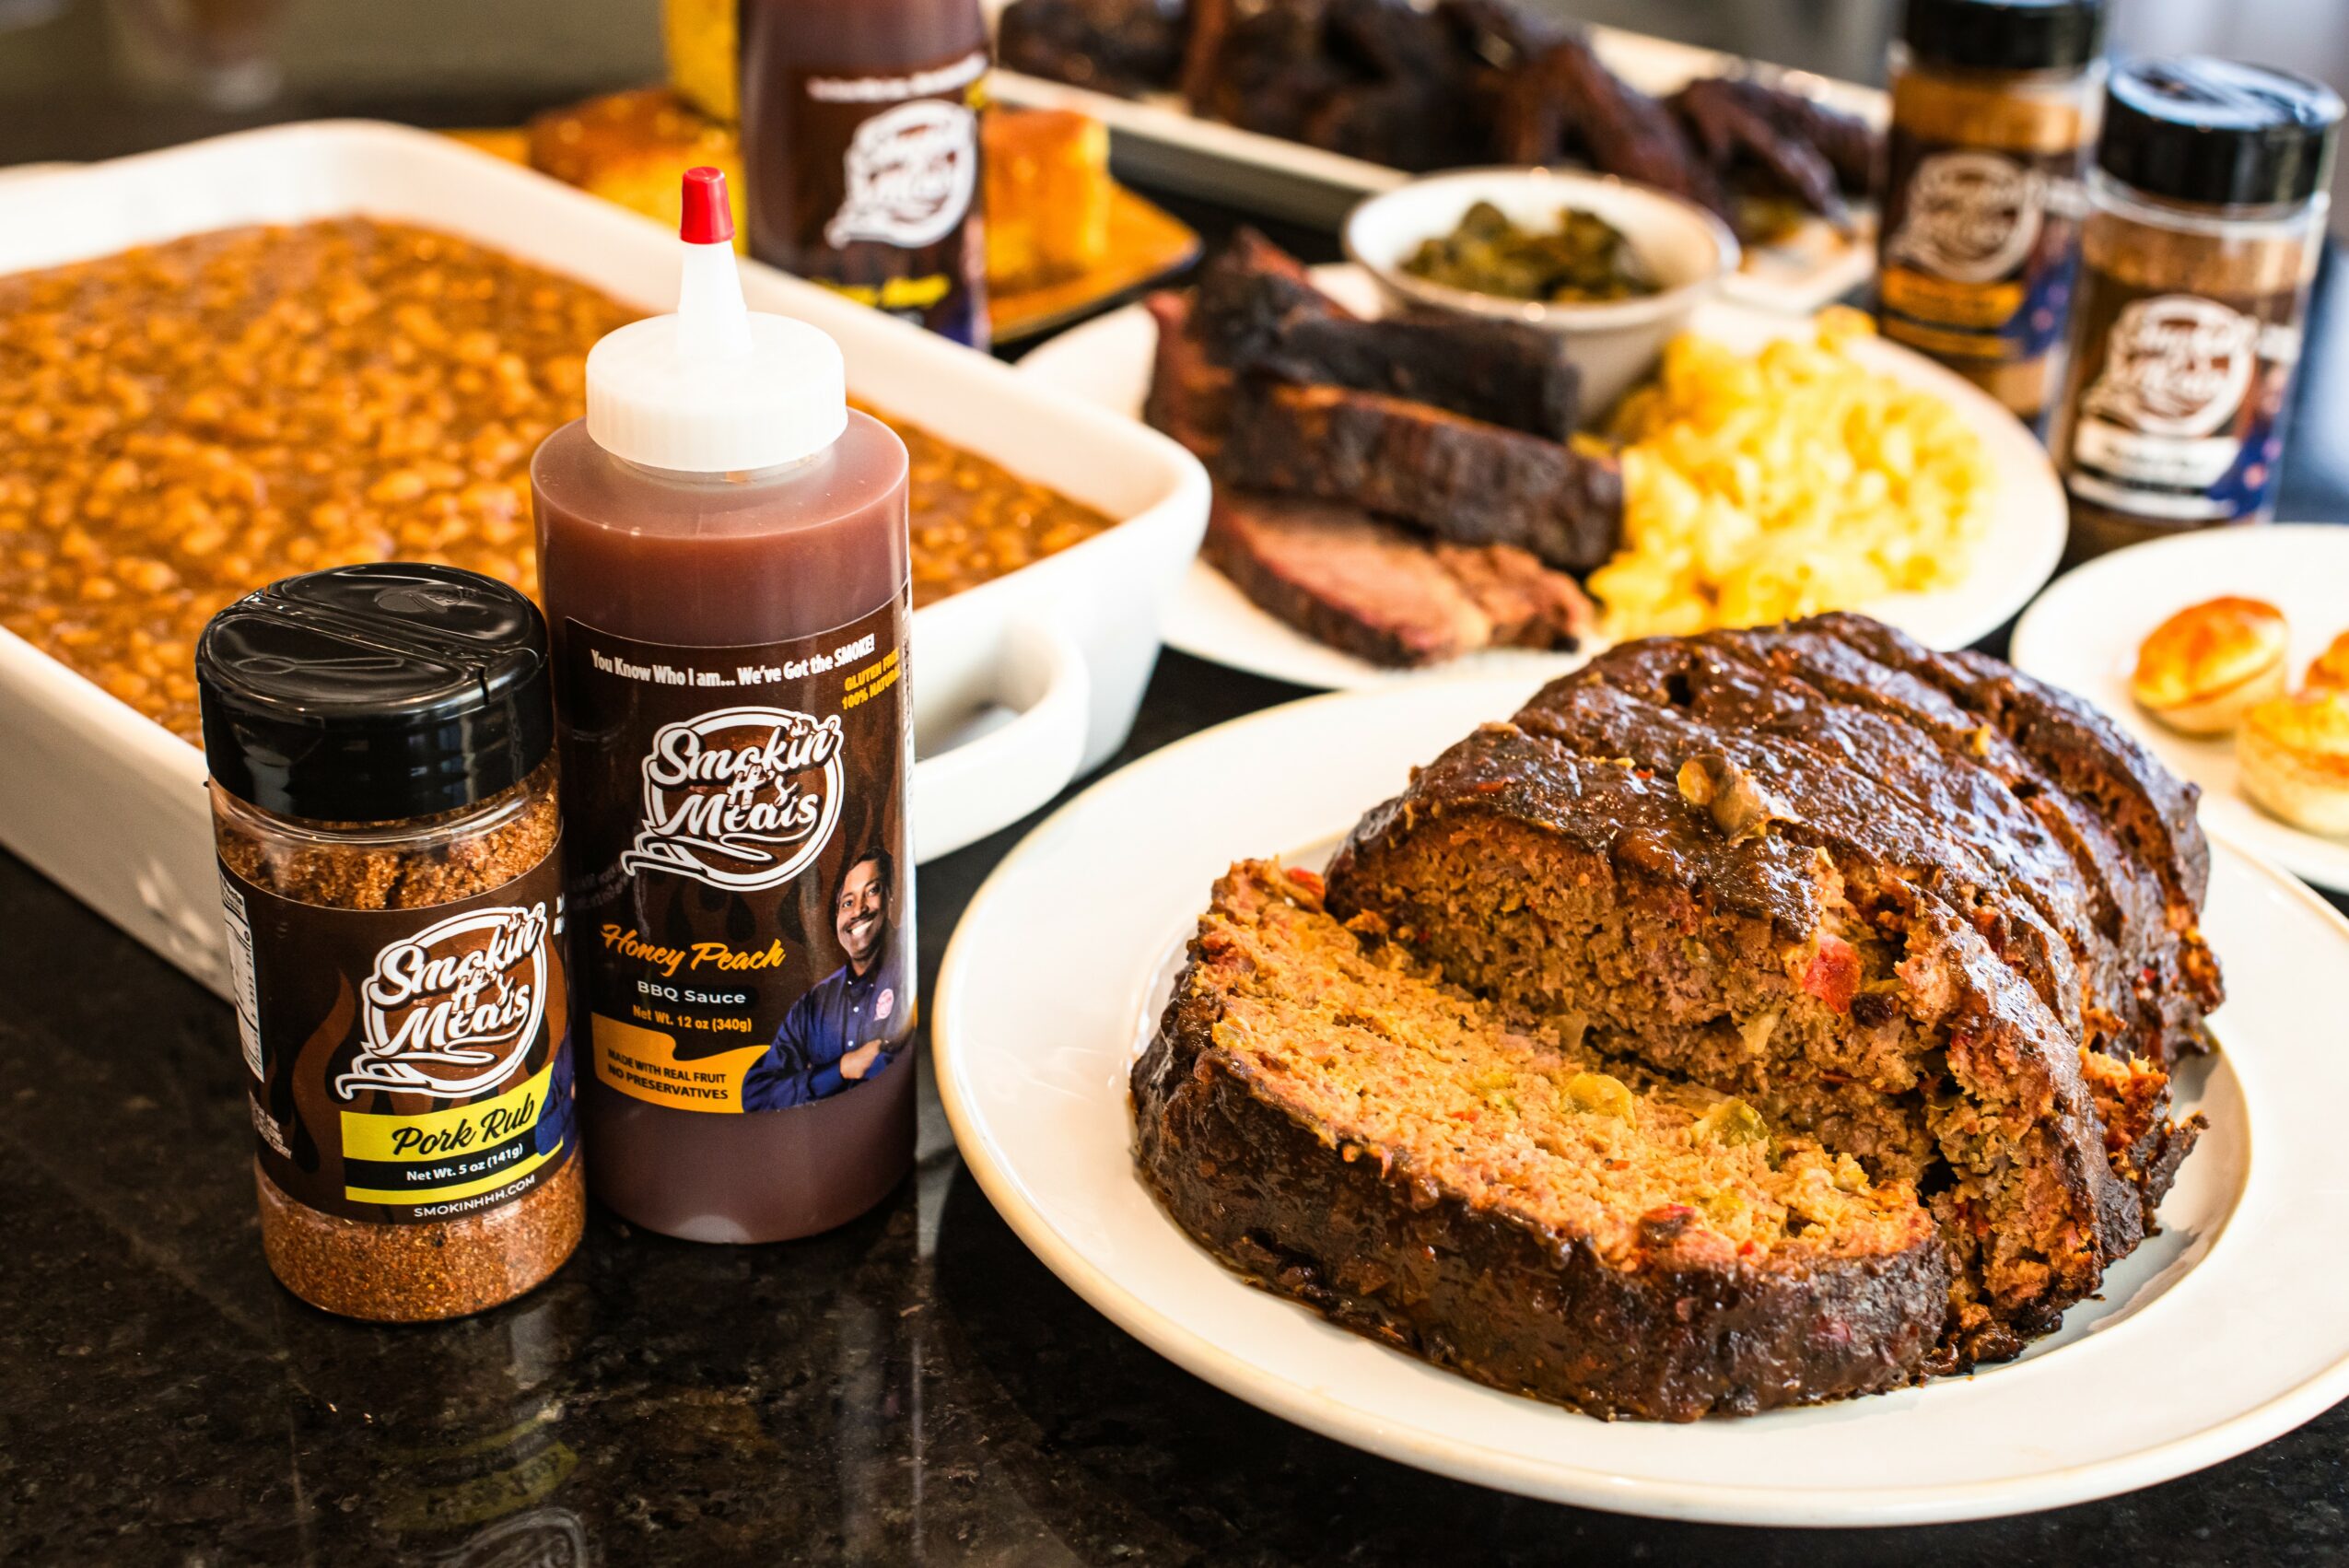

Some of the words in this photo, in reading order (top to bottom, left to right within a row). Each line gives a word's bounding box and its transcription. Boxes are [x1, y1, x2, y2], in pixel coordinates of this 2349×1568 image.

[590, 649, 614, 673] You
[614, 656, 651, 682] Know
[652, 664, 686, 686] Who
[688, 667, 695, 686] I
[696, 672, 736, 686] am...
[737, 664, 782, 685] We've
[783, 659, 810, 680] Got
[810, 653, 834, 674] the
[845, 661, 882, 692] GLUTEN
[842, 687, 869, 709] 100%
[649, 793, 819, 838] Meats
[600, 924, 686, 977] Honey
[691, 938, 787, 971] Peach
[637, 980, 679, 1002] BBQ
[684, 990, 747, 1004] Sauce
[368, 984, 531, 1058] Meats
[633, 1005, 651, 1022] Net
[654, 1011, 674, 1025] Wt.
[677, 1015, 692, 1028] 12
[695, 1019, 709, 1030] oz
[712, 1017, 753, 1033] (340g)
[608, 1047, 635, 1069] MADE
[635, 1059, 661, 1076] WITH
[663, 1068, 691, 1082] REAL
[694, 1072, 727, 1083] FRUIT
[608, 1064, 625, 1079] NO
[626, 1072, 729, 1100] PRESERVATIVES
[392, 1118, 476, 1155] Pork
[481, 1092, 535, 1143] Rub
[406, 1169, 432, 1182] Net
[433, 1167, 455, 1179] Wt.
[459, 1164, 467, 1176] 5
[470, 1163, 485, 1173] oz
[487, 1142, 523, 1169] (141g)
[414, 1174, 535, 1218] SMOKINHHH.COM
